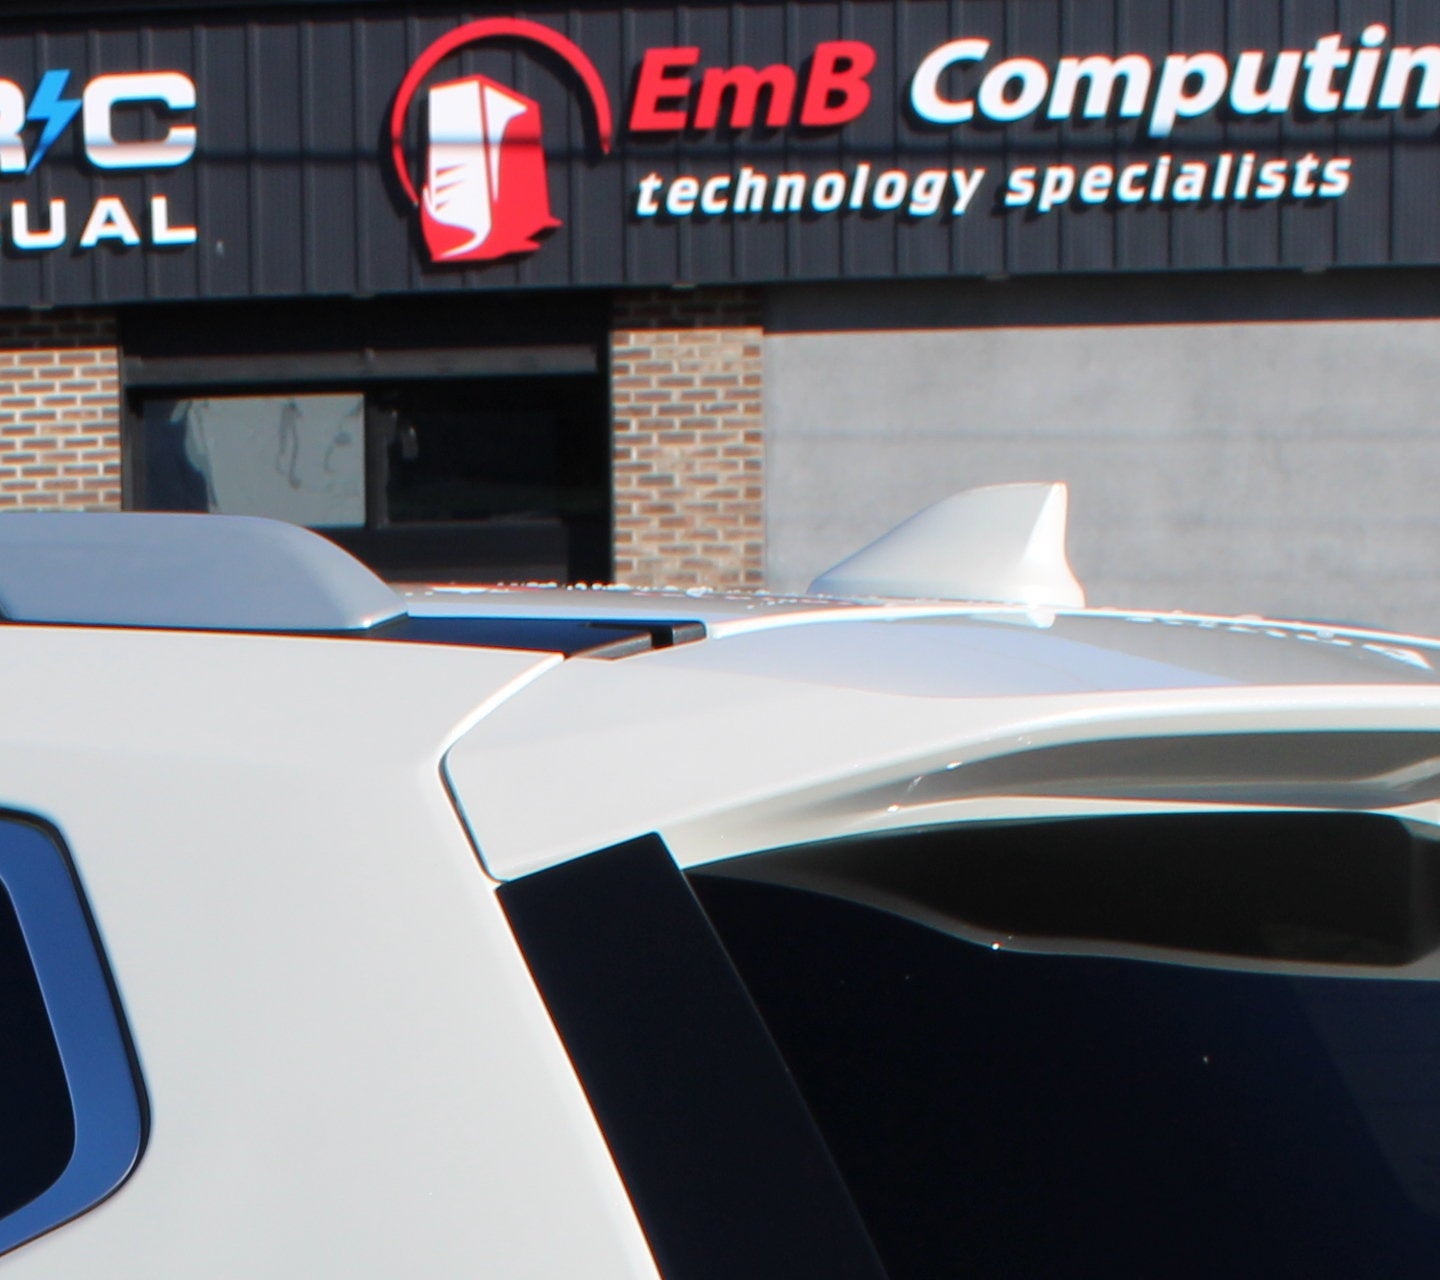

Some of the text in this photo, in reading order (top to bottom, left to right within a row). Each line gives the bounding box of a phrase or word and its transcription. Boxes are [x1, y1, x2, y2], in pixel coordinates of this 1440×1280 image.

[628, 39, 877, 133] EmB
[635, 152, 1353, 217] technology specialists
